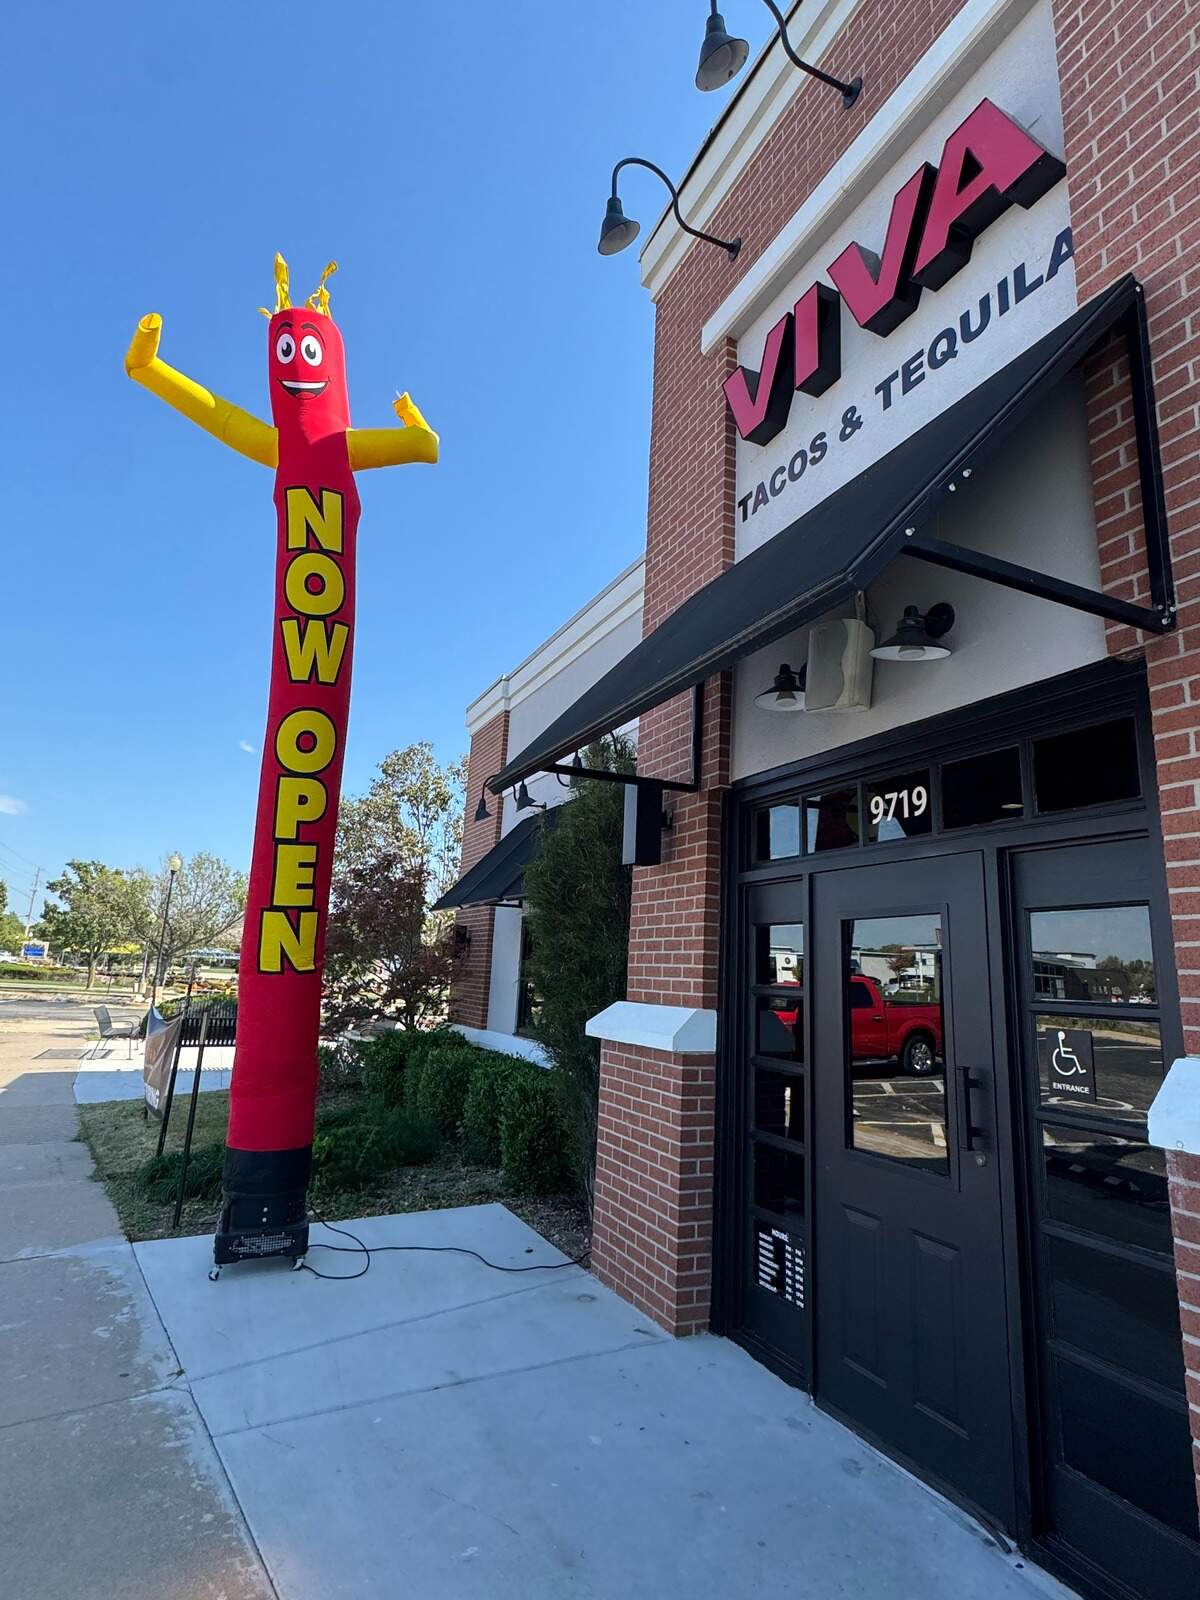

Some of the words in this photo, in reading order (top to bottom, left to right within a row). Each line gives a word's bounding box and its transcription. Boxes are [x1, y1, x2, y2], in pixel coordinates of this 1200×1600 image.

[722, 97, 1066, 447] VIVA
[737, 431, 828, 523] TACOS
[839, 405, 863, 442] &
[875, 226, 1074, 411] TEQUILA
[280, 486, 350, 685] NOW
[257, 707, 337, 976] OPEN
[870, 785, 927, 825] 9719
[1053, 1082, 1090, 1094] ENTRANCE
